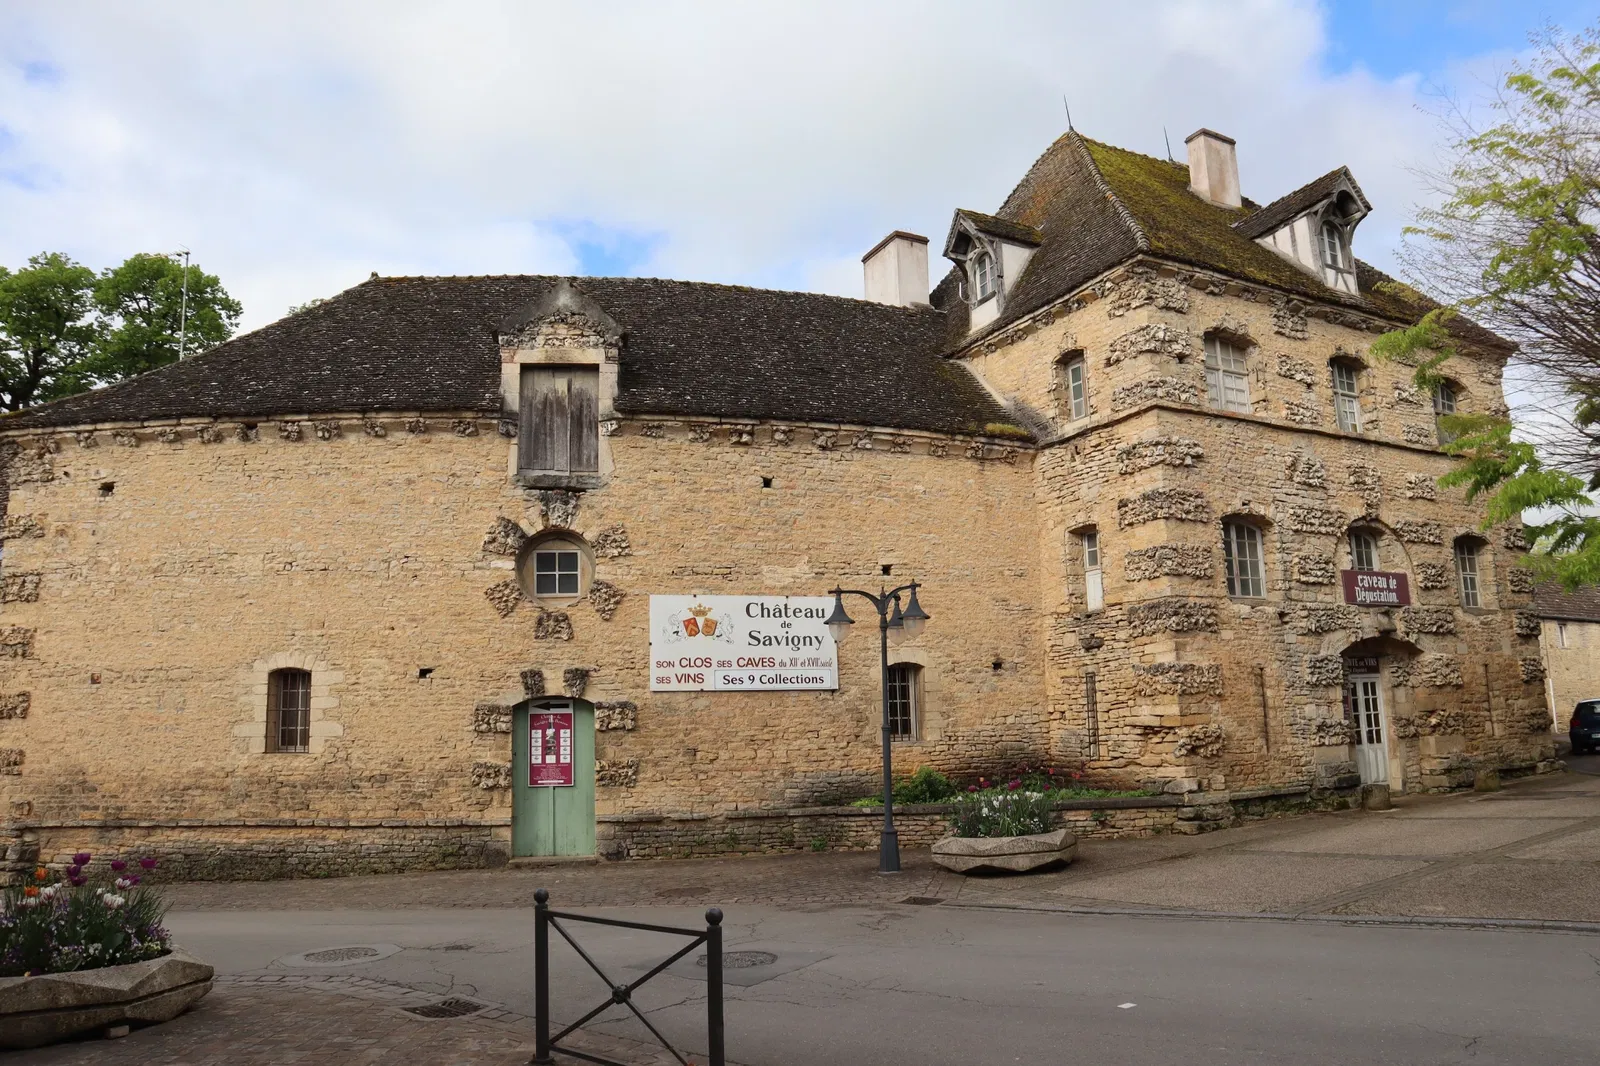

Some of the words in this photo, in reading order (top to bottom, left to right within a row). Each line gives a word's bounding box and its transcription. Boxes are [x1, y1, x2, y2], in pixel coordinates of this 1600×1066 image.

[1389, 576, 1397, 589] de
[745, 602, 826, 619] Château
[780, 620, 792, 629] de
[748, 630, 824, 651] Savigny
[656, 660, 675, 669] SON
[679, 657, 712, 668] CLOS
[716, 660, 733, 668] SES
[736, 656, 776, 668] CAVES
[778, 658, 787, 668] du
[800, 658, 806, 668] et
[655, 676, 672, 684] SES
[675, 672, 705, 684] VINS
[722, 674, 744, 685] Ses
[748, 674, 755, 685] 9
[759, 673, 825, 685] Collections
